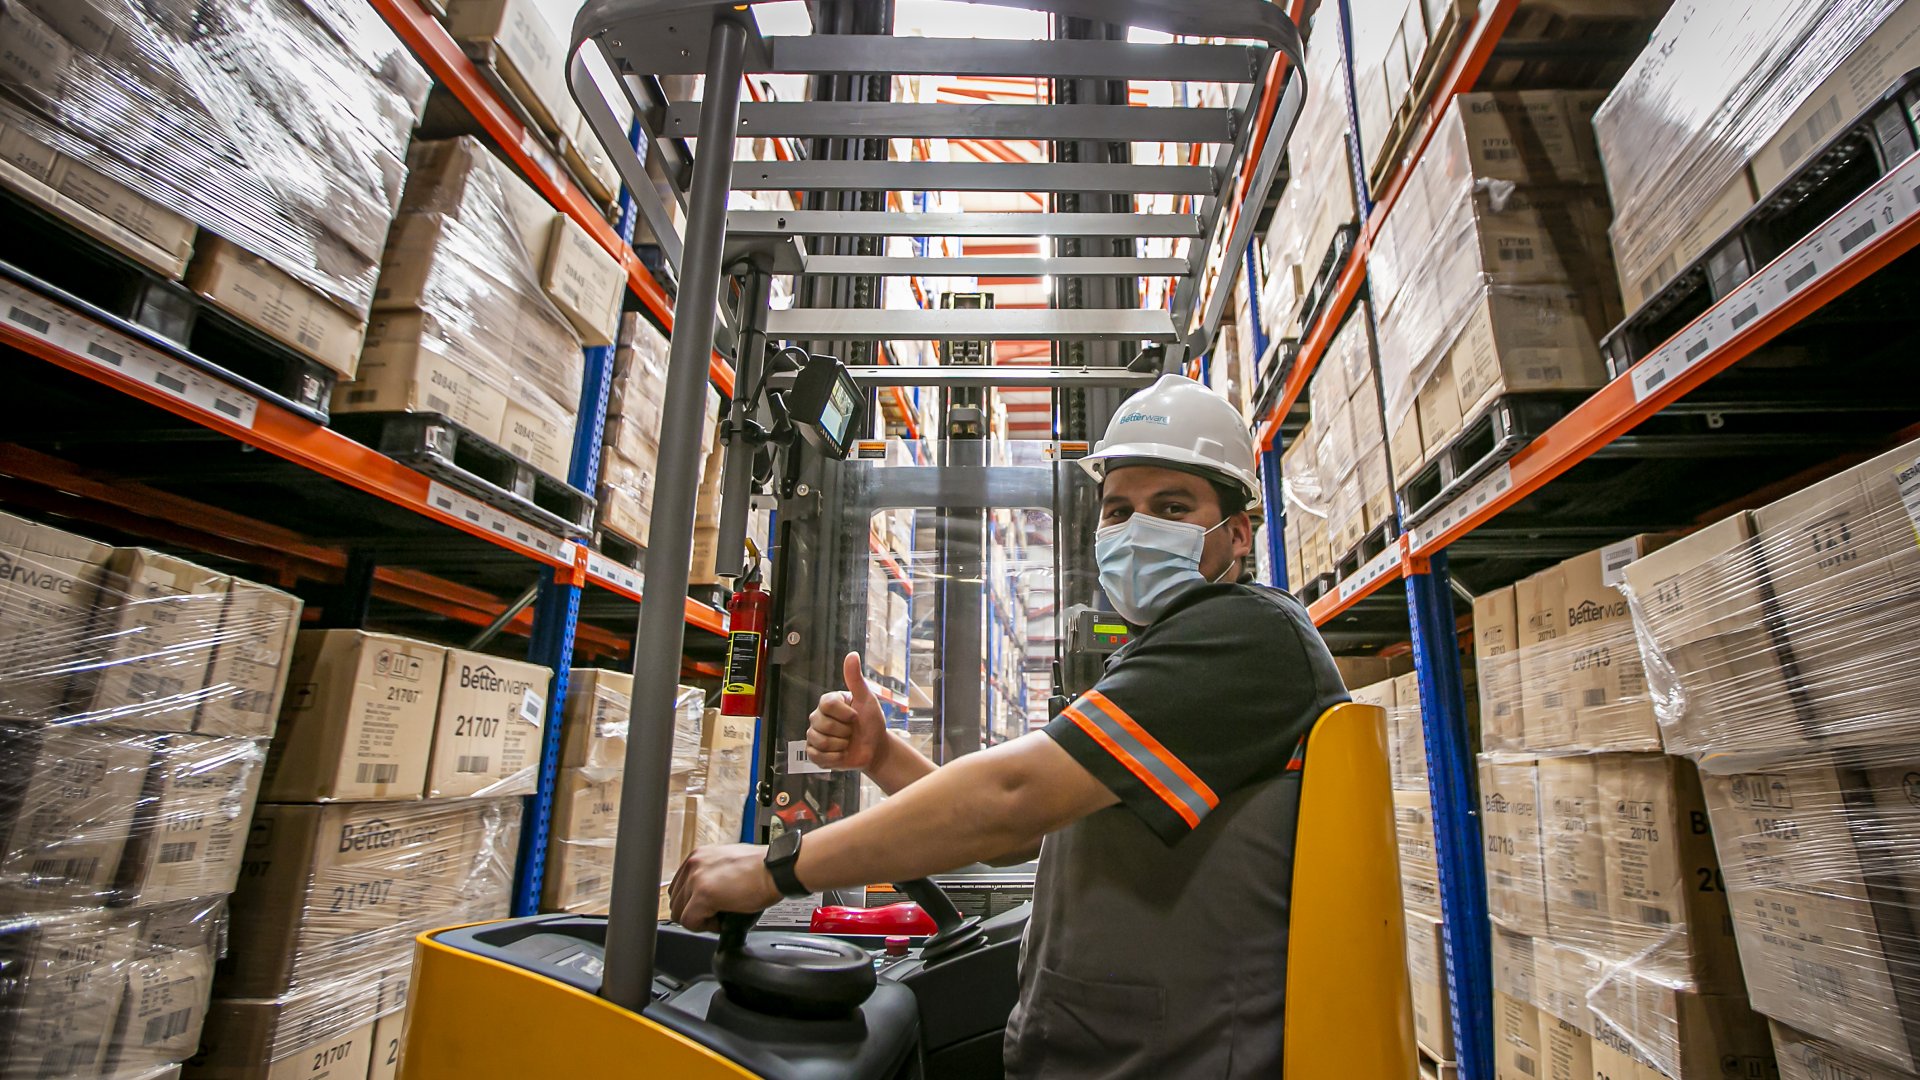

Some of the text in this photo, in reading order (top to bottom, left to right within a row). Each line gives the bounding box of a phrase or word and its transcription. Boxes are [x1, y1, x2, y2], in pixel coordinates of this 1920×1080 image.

[455, 715, 499, 738] 21707
[1488, 835, 1515, 856] 20713
[1629, 827, 1659, 842] 20713
[329, 879, 394, 914] 21707
[312, 1040, 353, 1072] 21707
